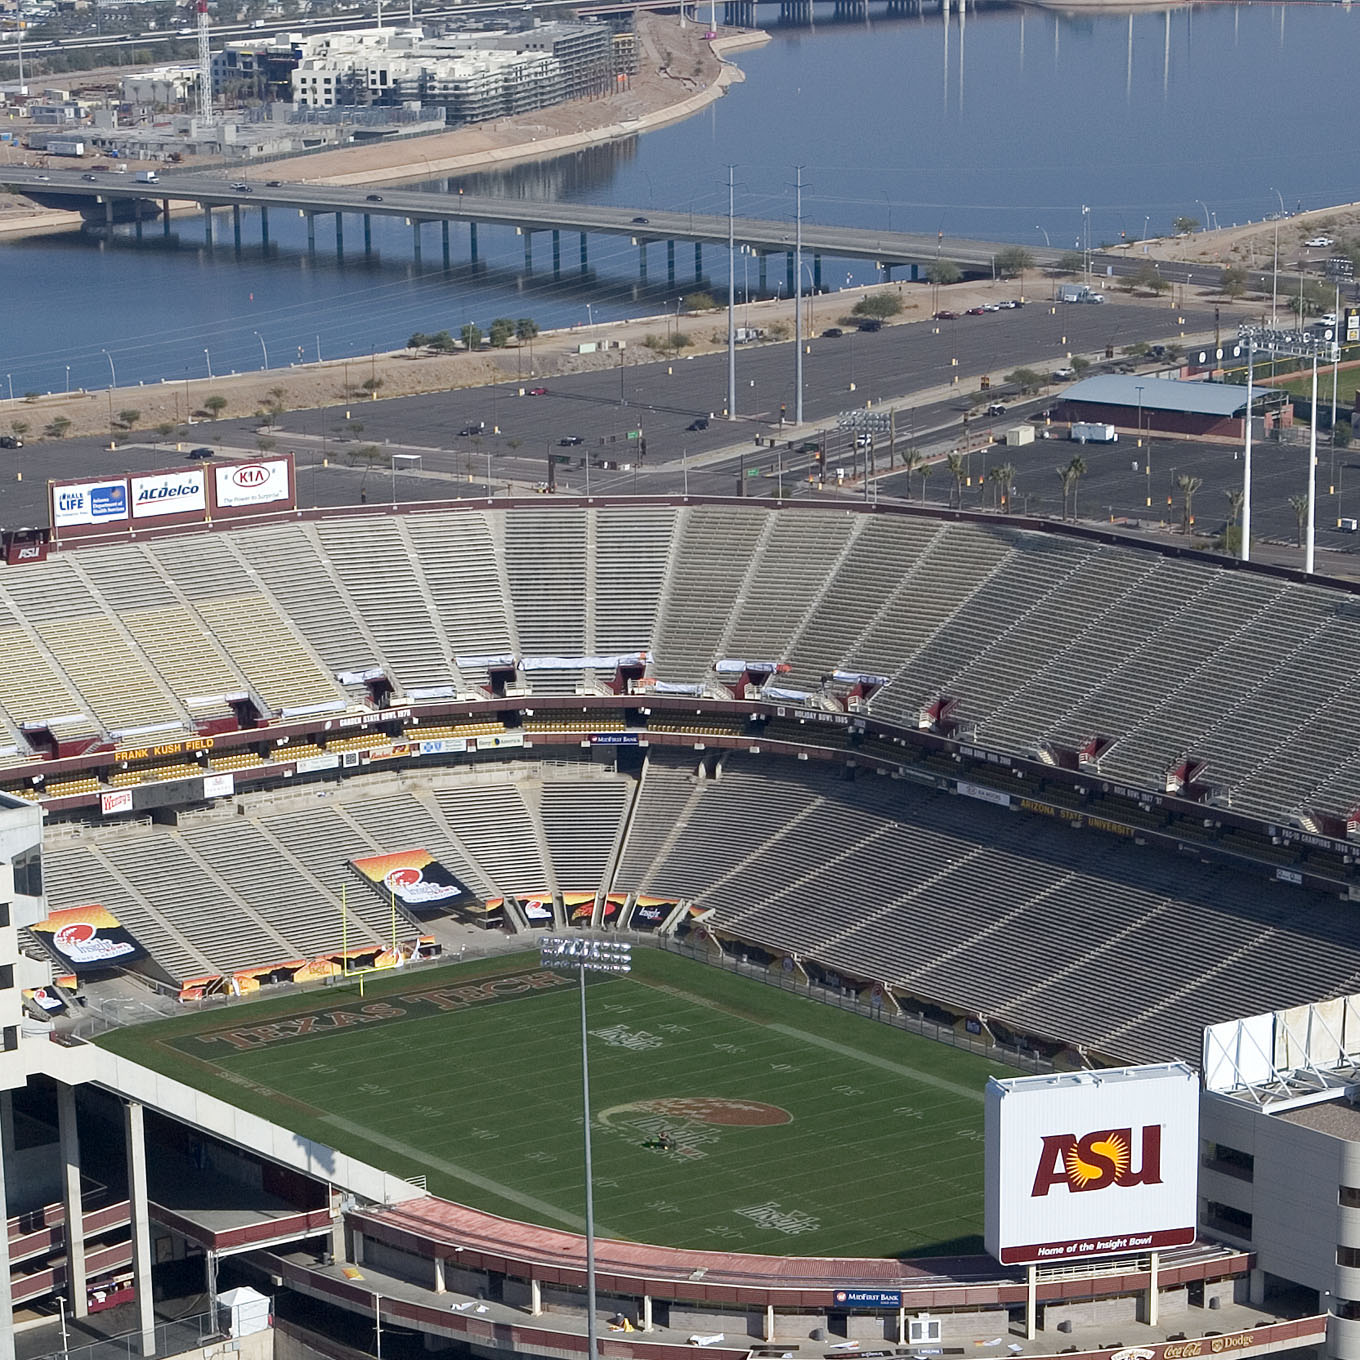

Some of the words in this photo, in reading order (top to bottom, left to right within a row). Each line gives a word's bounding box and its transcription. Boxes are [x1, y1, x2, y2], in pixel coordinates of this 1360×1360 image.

[240, 471, 264, 483] KIA
[138, 484, 200, 501] ACDelco
[59, 499, 84, 511] LIFE
[18, 547, 40, 560] ASU
[794, 710, 817, 720] HOLIDAY
[818, 713, 834, 722] BOWL
[115, 748, 149, 762] FRANK
[154, 744, 182, 756] KUSH
[186, 738, 215, 751] FIELD
[1020, 799, 1055, 816] ARIZONA
[1060, 809, 1083, 822] STATE
[1088, 817, 1137, 837] UNIVERSITY
[196, 1002, 407, 1050] TEXAS
[402, 970, 577, 1010] TECH
[587, 1024, 664, 1051] Insight
[1030, 1123, 1165, 1198] ASU
[733, 1201, 822, 1235] Insight
[1037, 1244, 1064, 1257] Home
[1066, 1243, 1078, 1255] of
[1079, 1242, 1094, 1253] the
[1095, 1238, 1127, 1253] Insight
[1129, 1234, 1153, 1248] Bowl
[880, 1293, 899, 1301] BANK
[1224, 1333, 1254, 1348] Dodge
[1163, 1341, 1203, 1360] Coca-Cola
